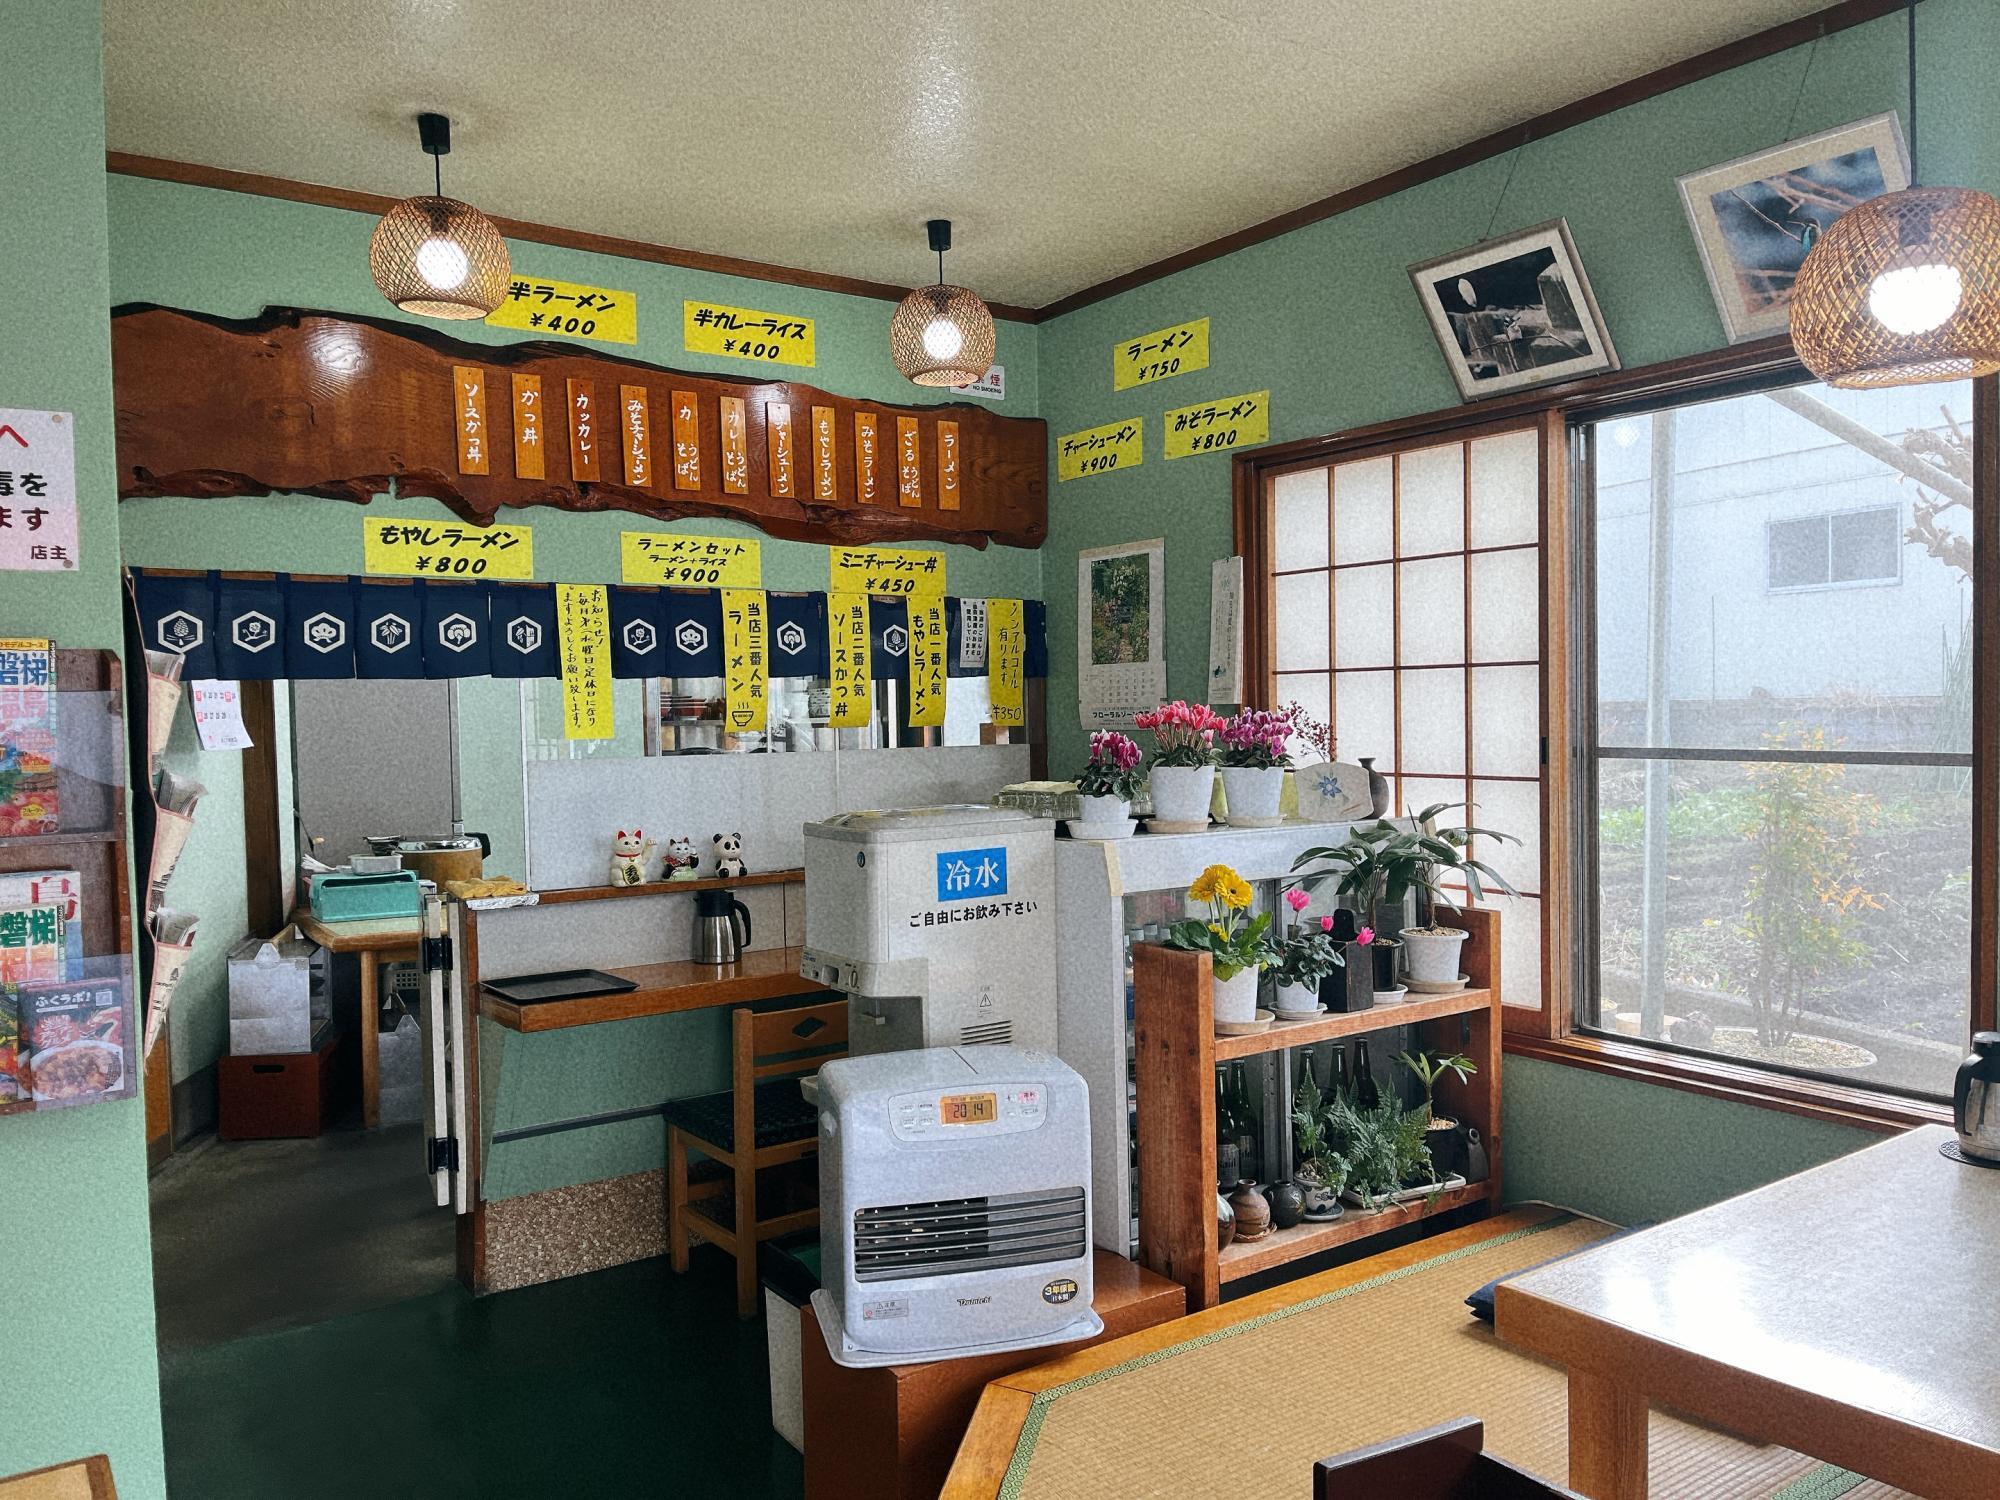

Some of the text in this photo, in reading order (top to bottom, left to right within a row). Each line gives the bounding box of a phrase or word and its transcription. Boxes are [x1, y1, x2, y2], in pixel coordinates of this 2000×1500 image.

[508, 281, 616, 312] 半ラーメン
[530, 312, 596, 335] ¥400
[693, 308, 806, 340] 半カレーライス
[723, 338, 780, 360] ¥400
[1127, 330, 1194, 361] ラーメン
[1138, 358, 1180, 380] ¥750
[1174, 400, 1257, 432] みそラーメン
[726, 411, 747, 488] カレー うどん そば
[1063, 425, 1137, 457] チャーシューメン
[1191, 430, 1237, 451] ¥800
[677, 443, 689, 474] そば
[689, 443, 699, 482] うどん
[820, 420, 833, 496] もやしラーメン
[861, 425, 875, 498] みそラーメン
[901, 430, 920, 498] ざる うどん そば
[944, 434, 957, 490] ラーメン
[1080, 453, 1117, 473] ¥900
[30, 545, 67, 560] 店主
[380, 525, 520, 549] もやしラーメン
[637, 538, 746, 556] ラーメンセット
[415, 556, 487, 574] ¥800
[663, 567, 720, 583] ¥900
[839, 552, 937, 573] ミニチャーシュー丼
[865, 578, 915, 593] ¥450
[728, 610, 744, 692] ラーメン
[747, 603, 762, 698] 当店三番人気
[851, 606, 865, 697] 当店二番人気
[929, 608, 942, 695] 当店一番人気
[998, 627, 1009, 687] 有ります
[1009, 605, 1020, 689] ノンアルコール
[834, 613, 848, 717] ソースかつ丼
[913, 615, 926, 715] もやしラーメン
[991, 703, 1022, 721] ¥350
[945, 857, 1000, 891] 冷水
[909, 900, 1039, 928] ご自由にお飲み下さい
[953, 1103, 984, 1119] 20 14
